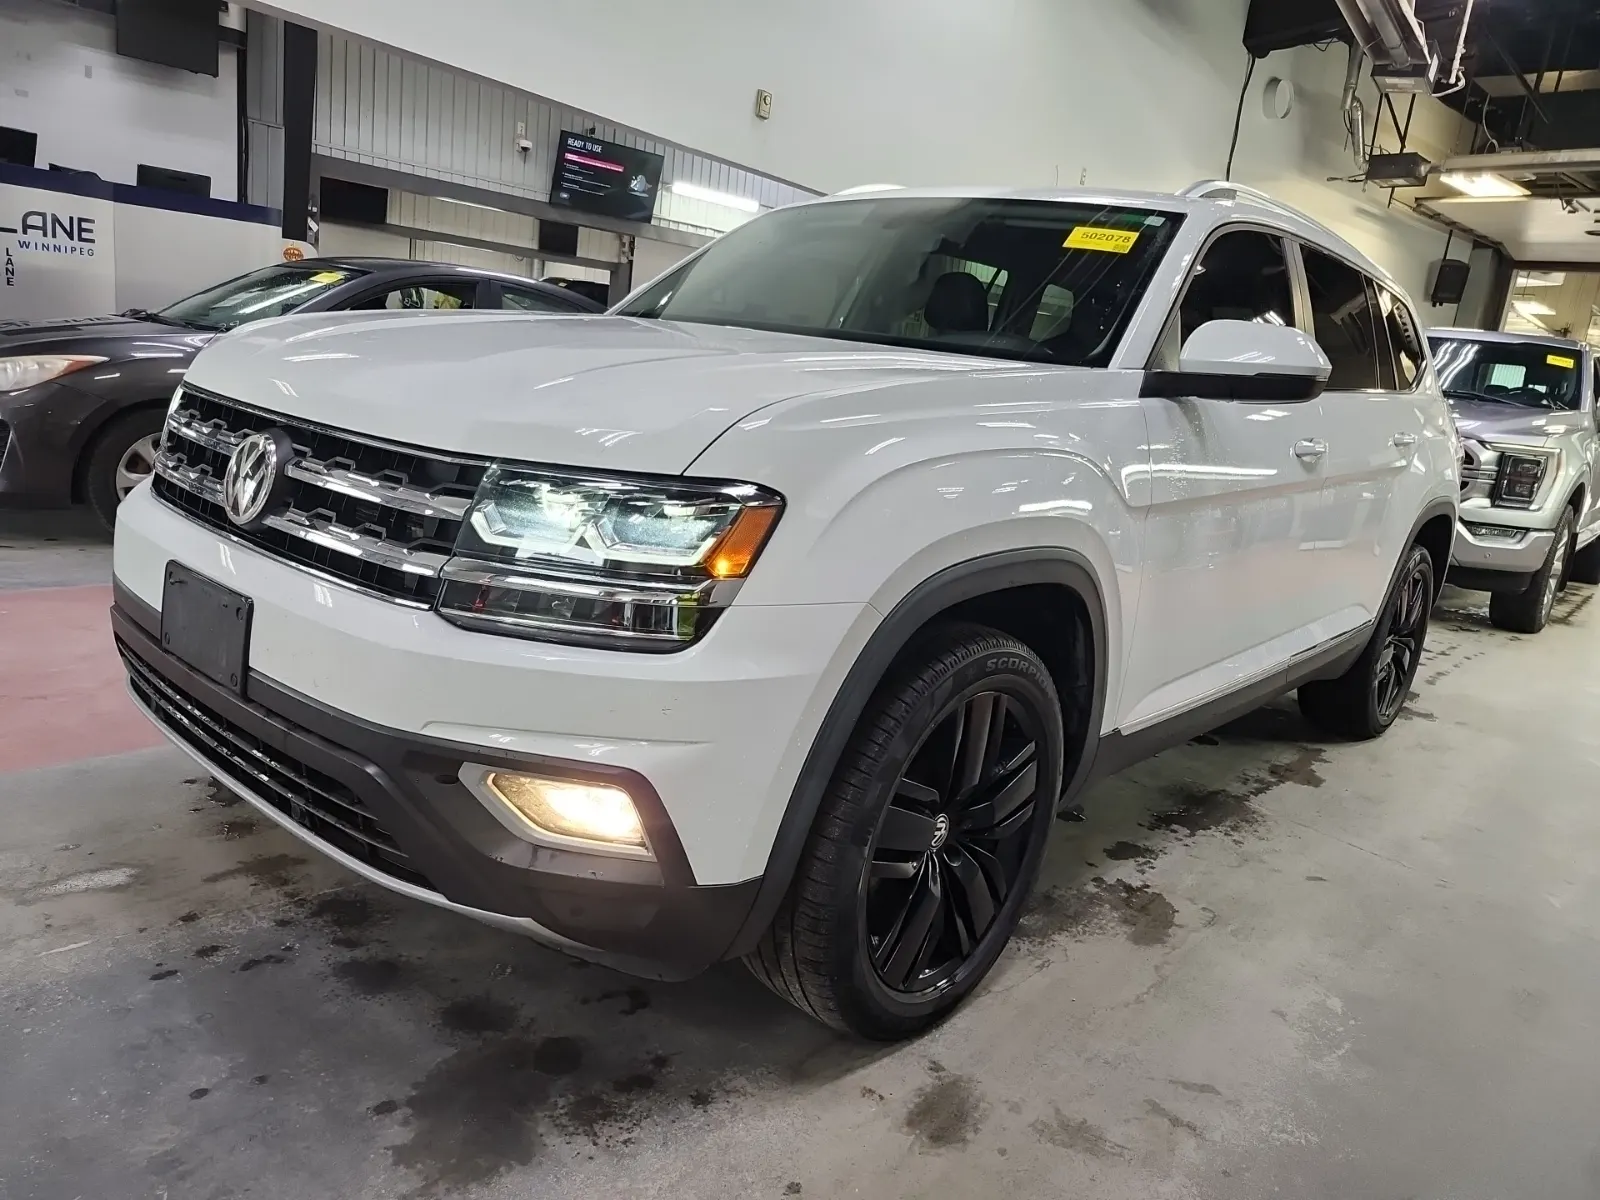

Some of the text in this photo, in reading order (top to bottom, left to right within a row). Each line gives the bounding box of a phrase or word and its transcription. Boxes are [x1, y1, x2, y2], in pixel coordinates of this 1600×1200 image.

[567, 137, 584, 148] READY
[585, 142, 593, 150] TO
[593, 144, 603, 153] USE
[1080, 231, 1132, 244] 502078
[18, 239, 95, 257] WINNIPEG
[5, 247, 15, 286] LANE
